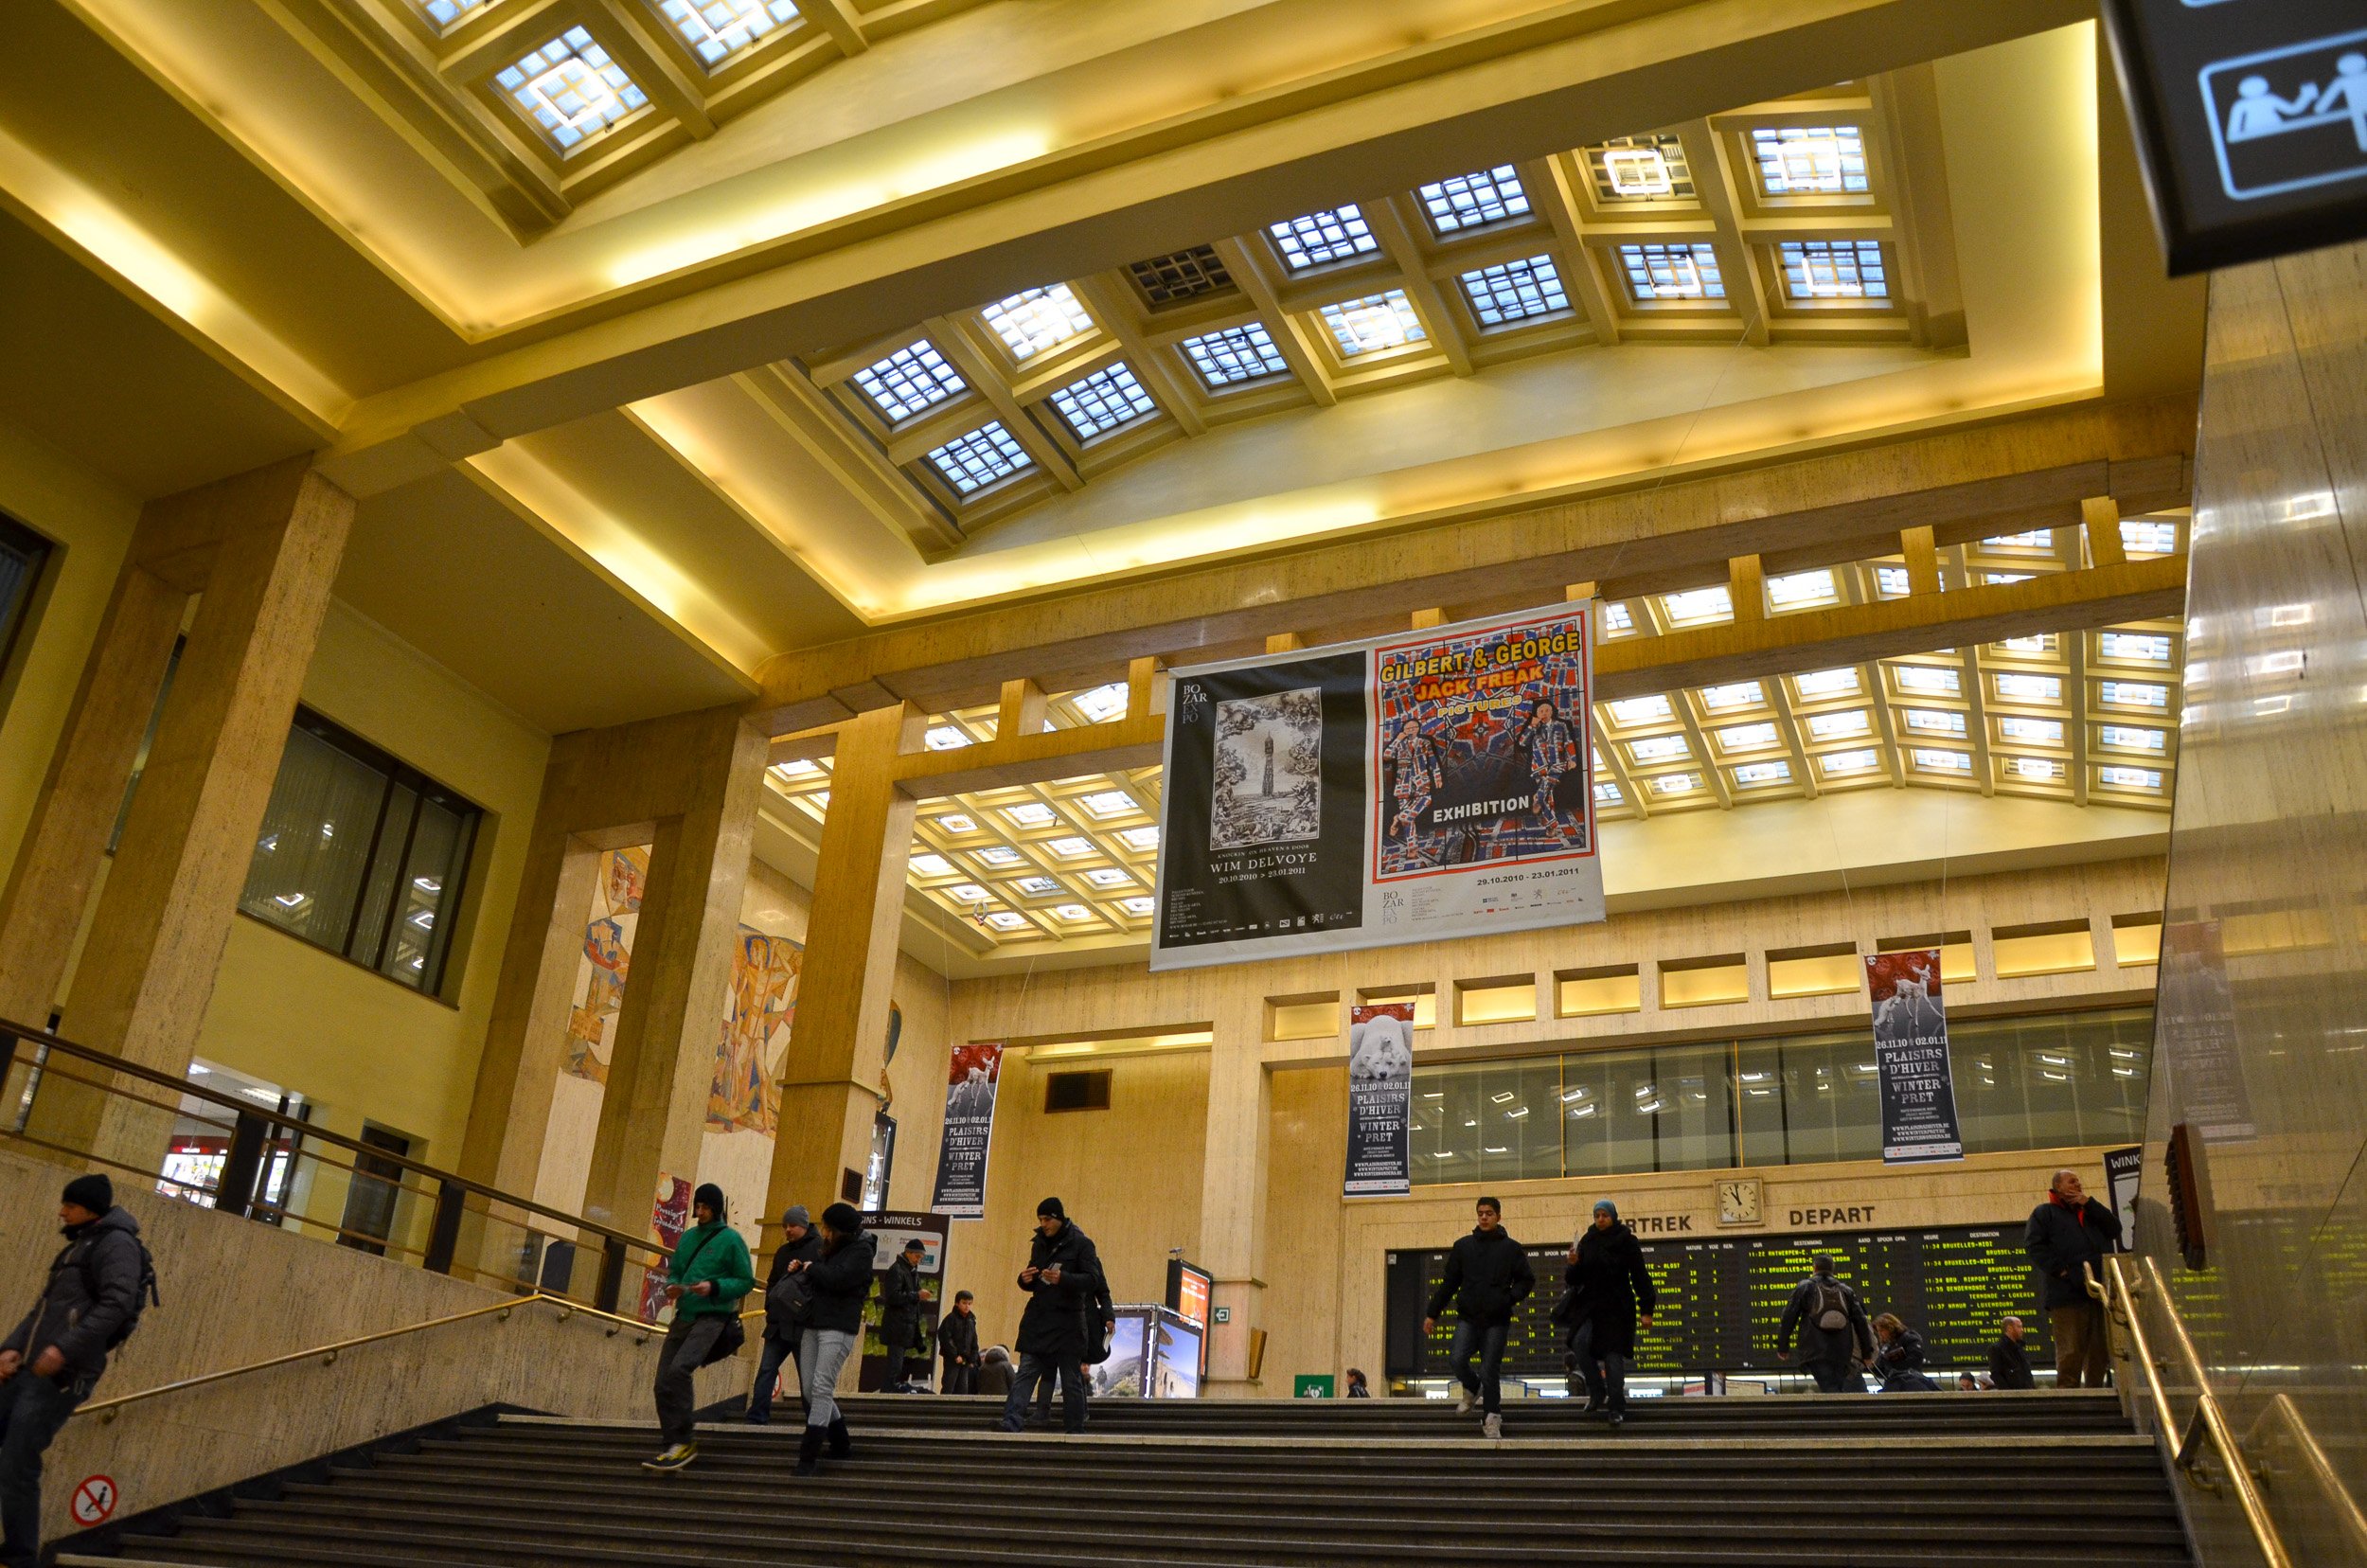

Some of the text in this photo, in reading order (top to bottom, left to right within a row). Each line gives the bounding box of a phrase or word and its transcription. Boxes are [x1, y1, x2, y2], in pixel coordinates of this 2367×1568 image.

[1380, 652, 1466, 683] GILBERT
[1472, 647, 1488, 668] &
[1495, 631, 1580, 662] GEORGE
[1415, 675, 1470, 702] JACK
[1475, 665, 1544, 692] FREAK
[1184, 684, 1201, 695] BO
[1183, 692, 1207, 704] ZAR
[1437, 695, 1522, 718] PICTURES
[1433, 795, 1530, 824] EXHIBITION
[1211, 852, 1318, 874] WIM DELVOYE
[1219, 873, 1257, 884] 20.10.2010
[1268, 866, 1307, 878] 23.01.2011
[1477, 874, 1523, 886] 29.10.2010
[1531, 867, 1579, 881] 23.01.2011
[1383, 890, 1398, 900] BO
[1383, 899, 1404, 909] ZAR
[1877, 1039, 1908, 1049] 26.11.10
[1885, 1048, 1942, 1062] PLAISIRS
[1890, 1060, 1940, 1075] D'HIVER
[1351, 1083, 1377, 1092] 26.11.10
[1892, 1078, 1942, 1092] WINTER
[1357, 1093, 1405, 1104] PLAISIRS
[1901, 1092, 1933, 1104] PRET
[1360, 1105, 1400, 1115] D'HIVER
[945, 1116, 966, 1125] 26.11.10
[1359, 1121, 1399, 1131] WINTER
[949, 1127, 988, 1136] PLAISIRS
[950, 1136, 984, 1146] D'HIVER
[1365, 1132, 1393, 1143] PRET
[949, 1151, 981, 1161] WINTER
[2110, 1154, 2141, 1168] WINK
[952, 1162, 974, 1171] PRET
[883, 1216, 922, 1226] WINKELS
[1789, 1206, 1875, 1226] DEPART
[1622, 1215, 1693, 1233] RTREK
[1942, 1240, 1993, 1249] BRUXELLES-MIDI
[1944, 1257, 1995, 1266] BRUXELLES-MIDI
